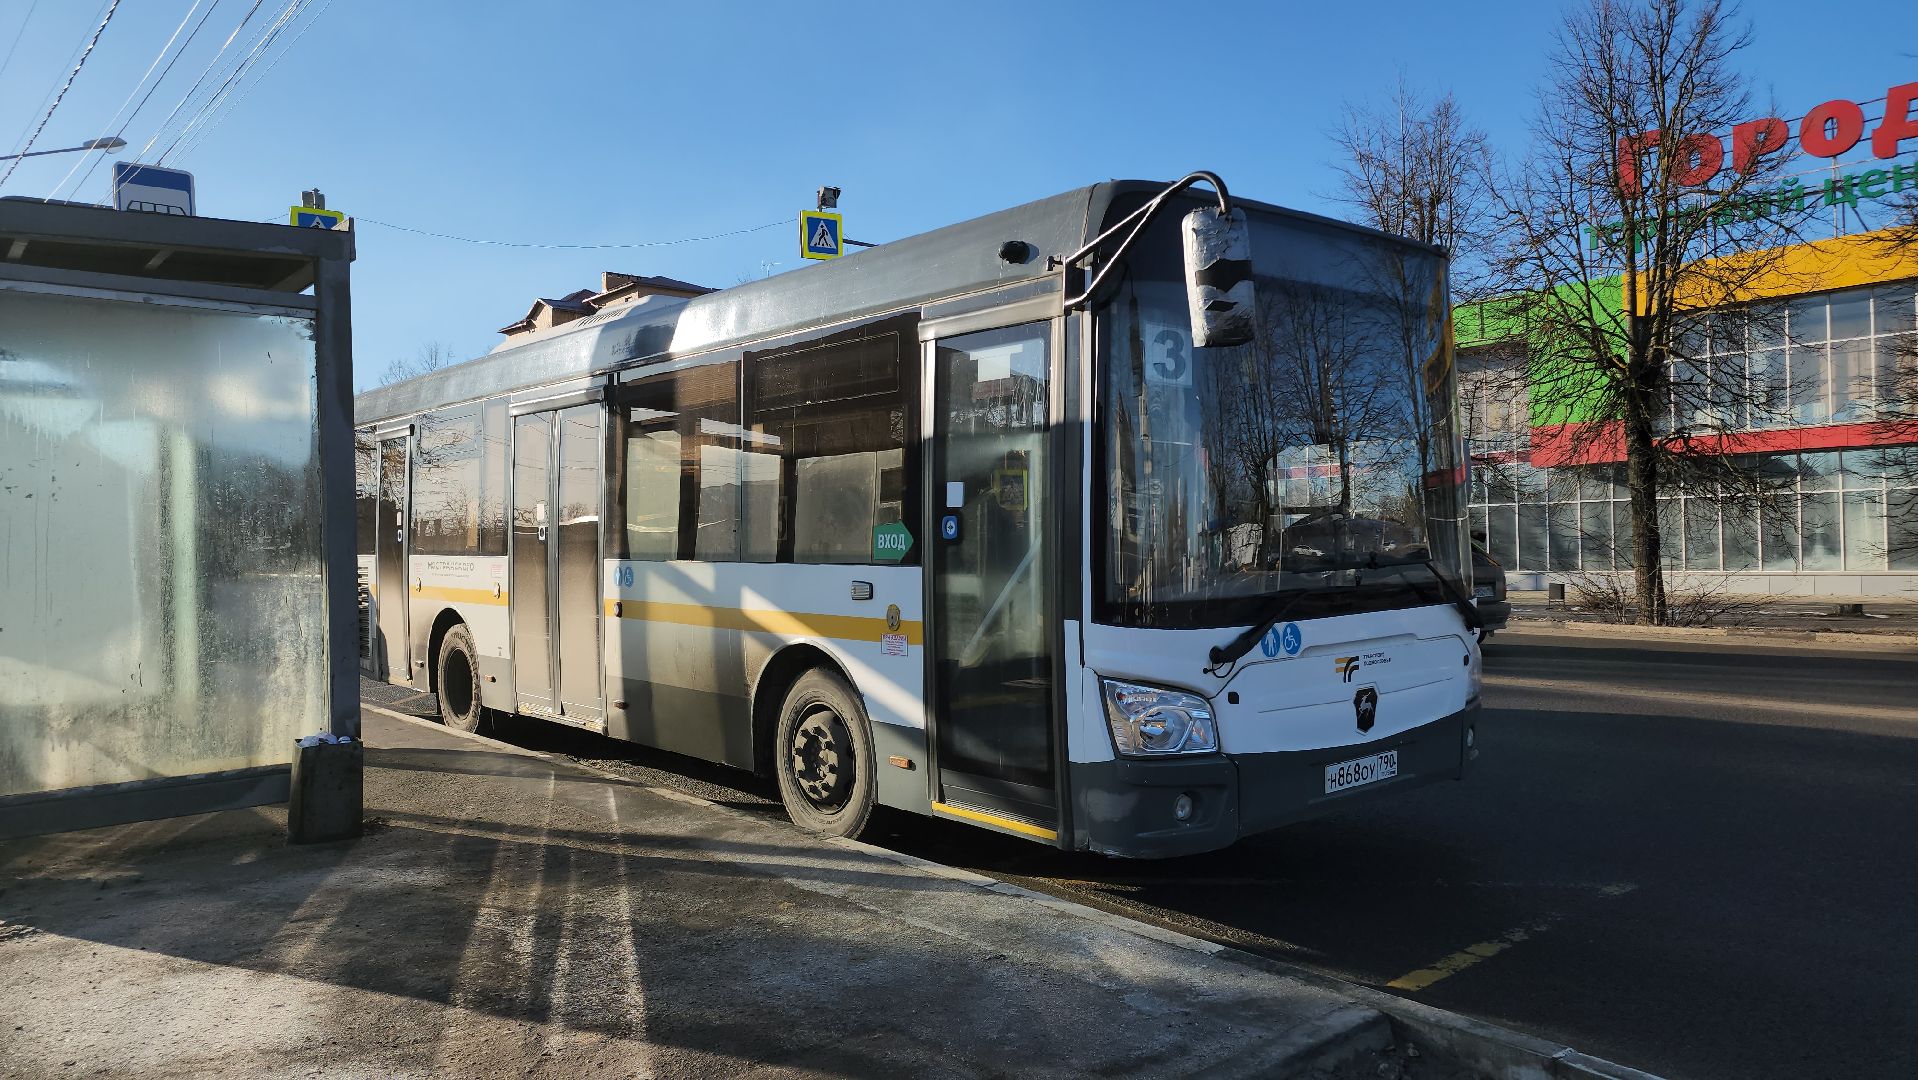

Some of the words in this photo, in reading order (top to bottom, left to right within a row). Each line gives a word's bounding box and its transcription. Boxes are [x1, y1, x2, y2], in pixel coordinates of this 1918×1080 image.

[1152, 328, 1187, 380] 3
[877, 533, 906, 551] ВХОД
[1378, 753, 1396, 771] 790
